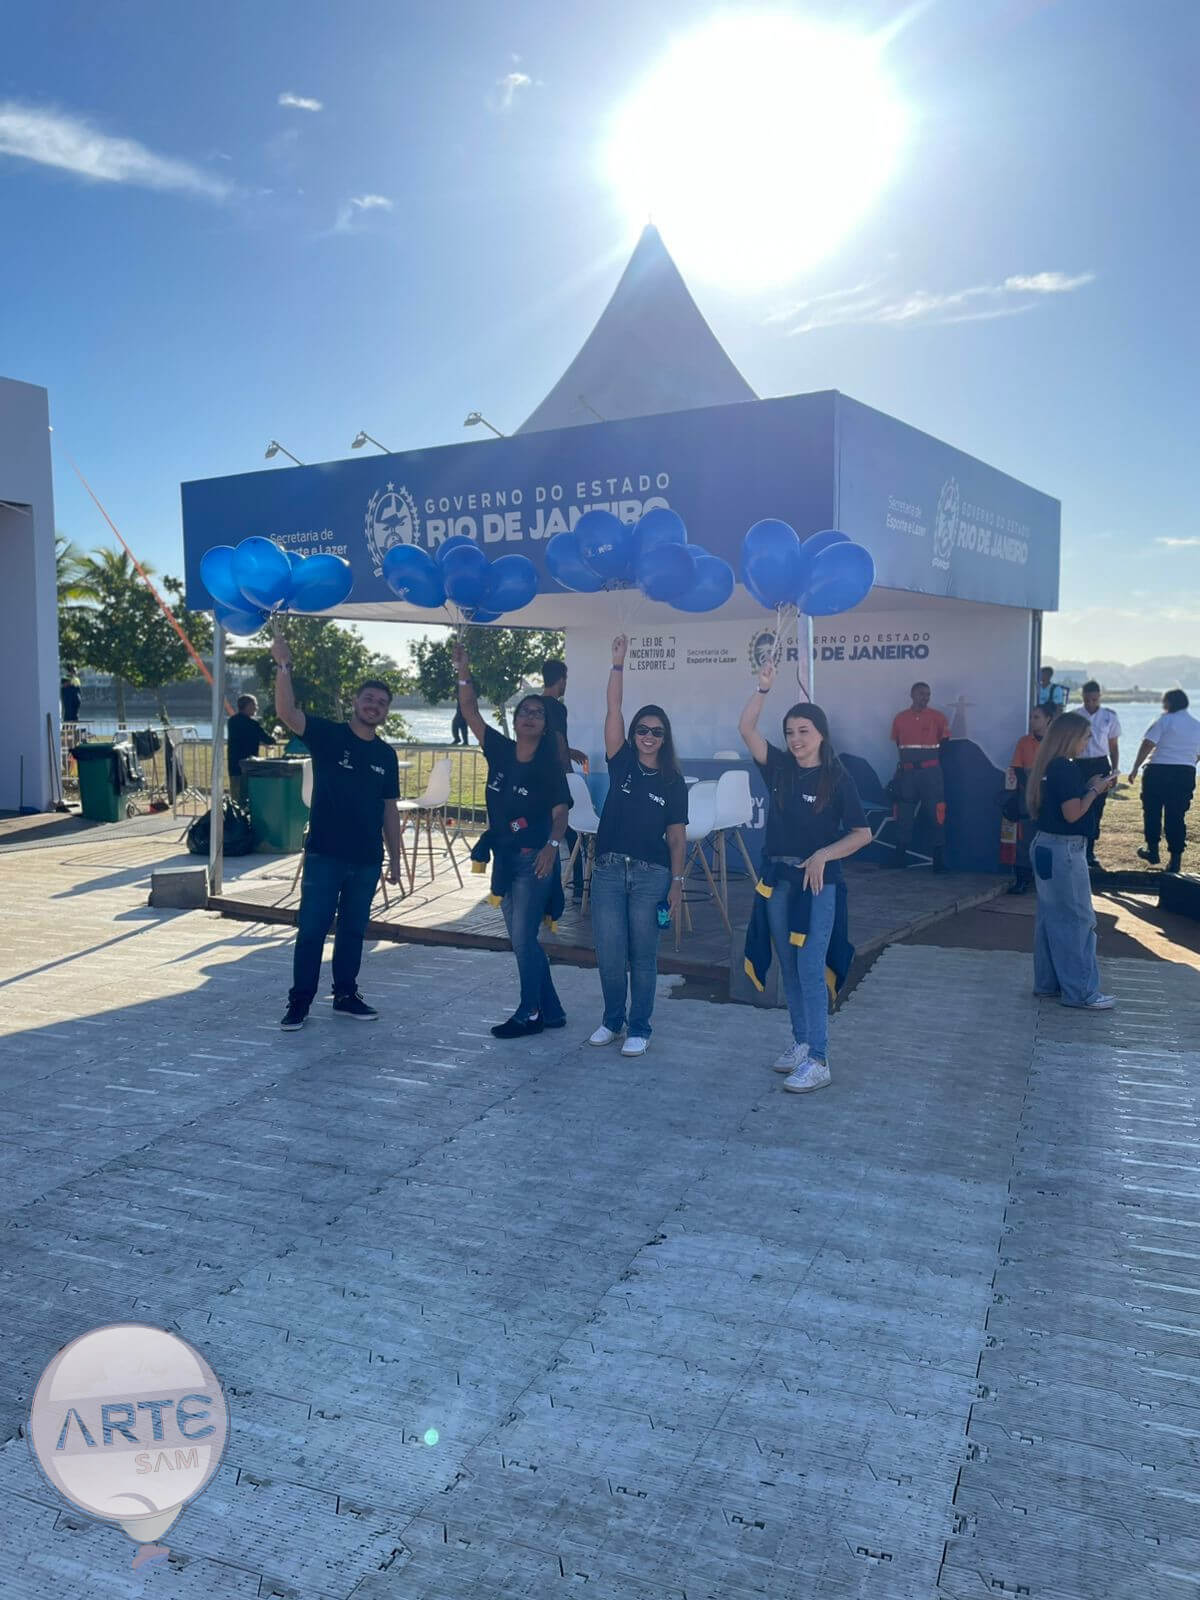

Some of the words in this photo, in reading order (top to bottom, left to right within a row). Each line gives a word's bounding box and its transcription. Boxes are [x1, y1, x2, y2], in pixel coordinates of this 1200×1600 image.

[425, 488, 523, 514] GOVERNO
[535, 484, 563, 503] DO
[576, 472, 670, 498] ESTADO
[426, 515, 478, 548] RIO
[482, 511, 524, 543] DE
[528, 496, 671, 540] JANIR
[270, 529, 319, 544] Secretaria
[320, 527, 335, 541] de
[959, 519, 977, 551] RIO
[976, 527, 992, 556] DE
[642, 636, 653, 648] LEI
[654, 637, 663, 647] DE
[853, 634, 871, 643] DO
[877, 632, 931, 643] ESTADO
[629, 648, 665, 659] INCENTIVO
[665, 648, 676, 658] AO
[820, 646, 845, 661] DE
[848, 643, 930, 661] JANEIRO
[637, 660, 667, 670] ESPORTE
